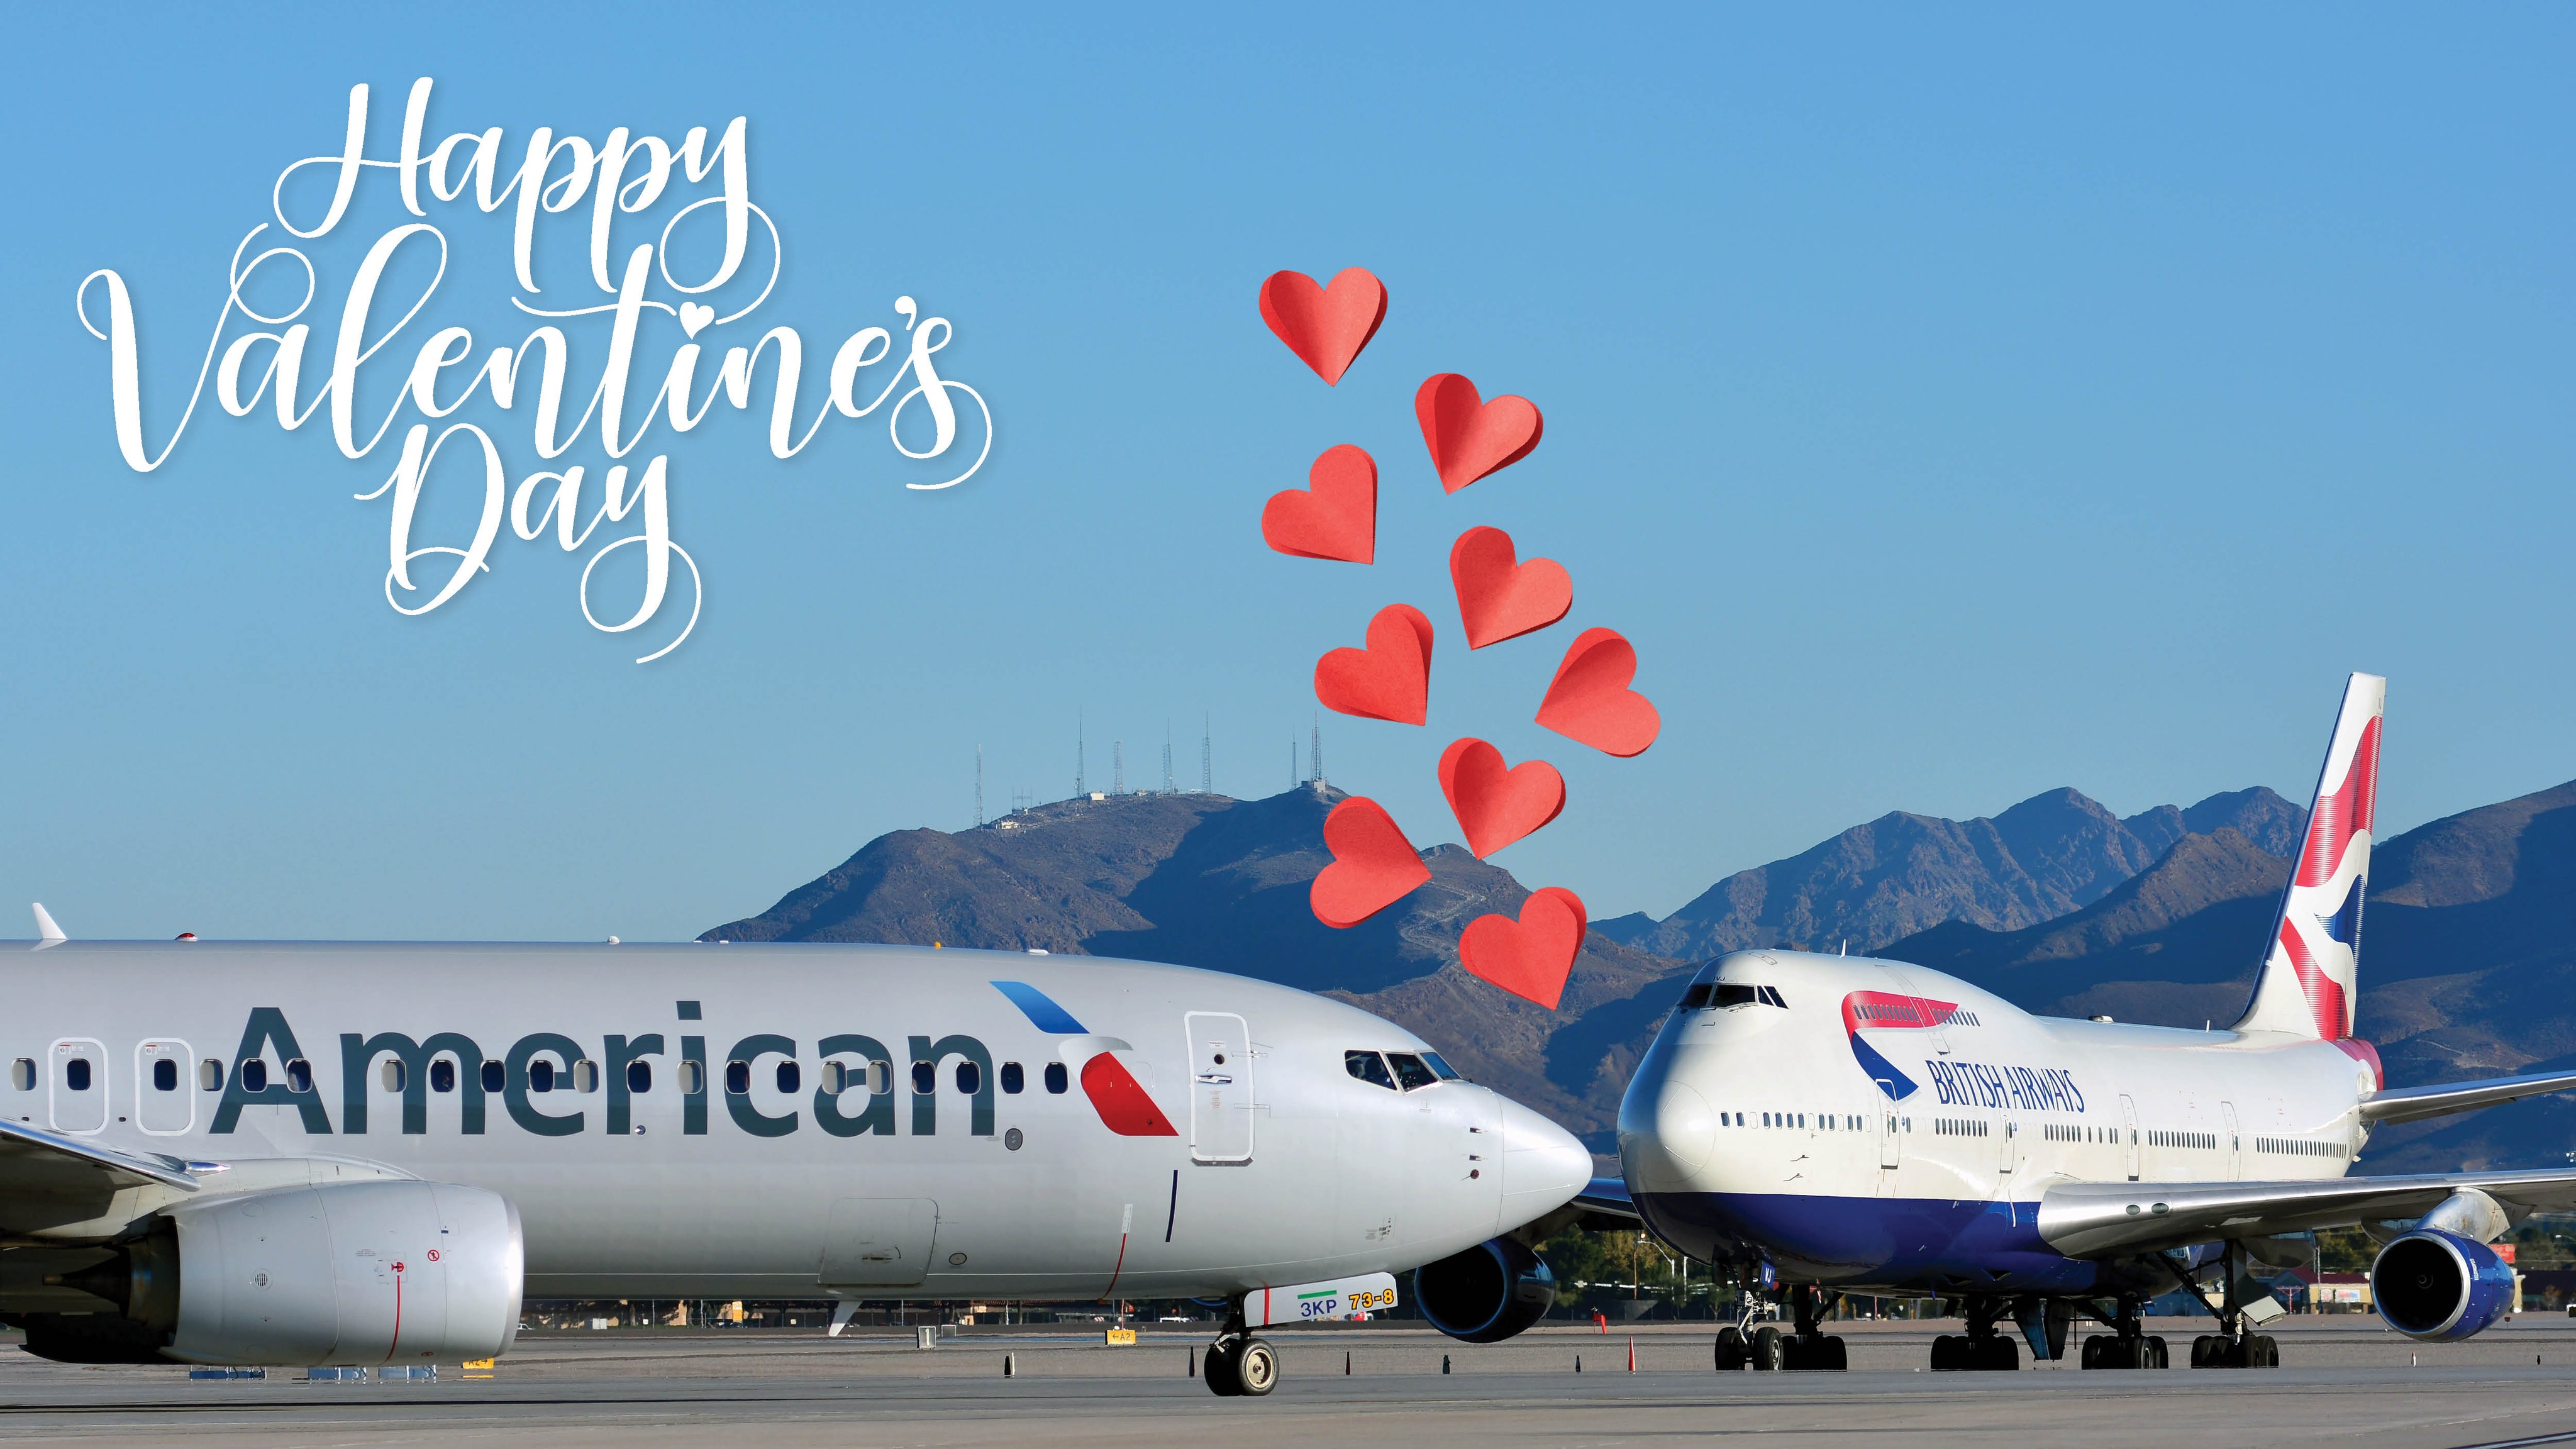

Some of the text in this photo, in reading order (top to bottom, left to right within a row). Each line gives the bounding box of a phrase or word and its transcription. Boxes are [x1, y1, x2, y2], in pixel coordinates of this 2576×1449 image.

[208, 1001, 996, 1137] American
[1925, 1060, 2085, 1113] BRITISH AIRWAYS
[1301, 1288, 1394, 1317] 3KP 73-8
[1120, 1333, 1131, 1341] A2
